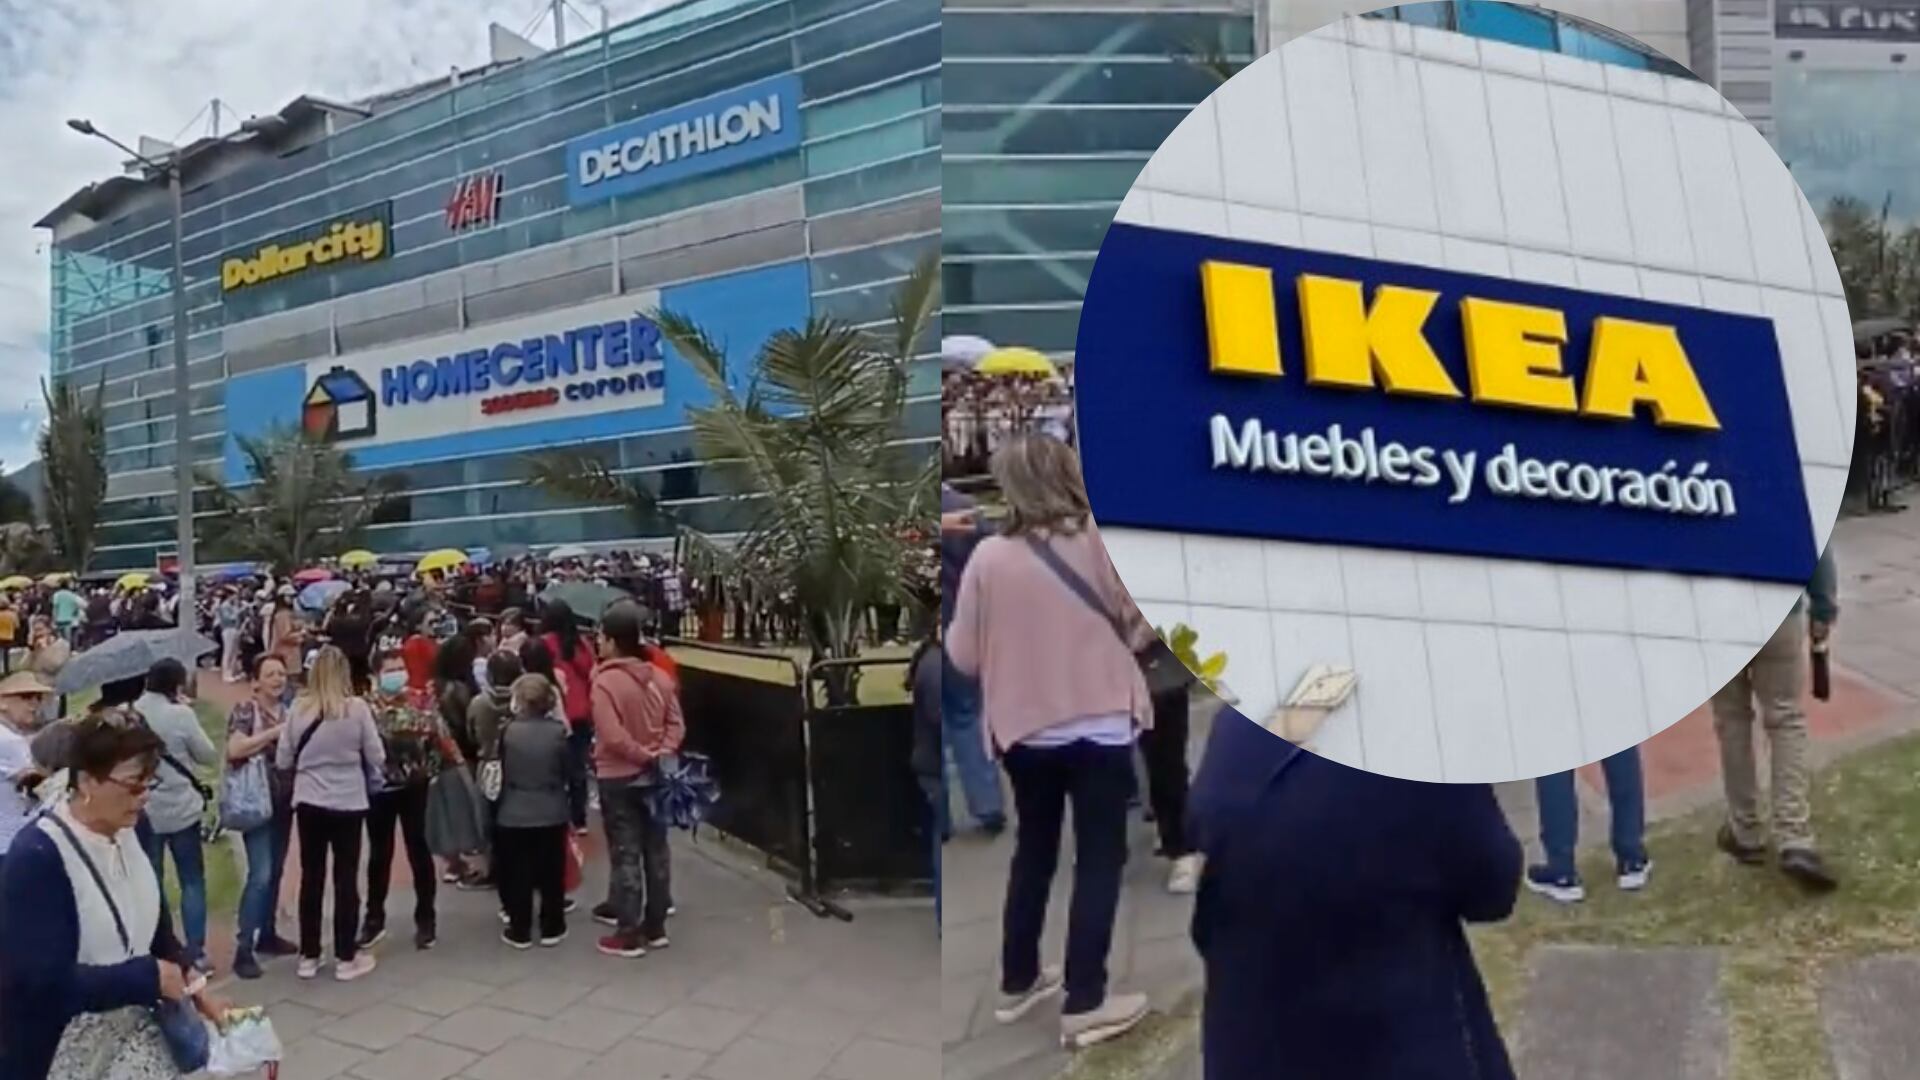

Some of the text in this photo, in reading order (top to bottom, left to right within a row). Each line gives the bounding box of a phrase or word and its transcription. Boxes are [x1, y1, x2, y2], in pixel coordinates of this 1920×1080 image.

[578, 94, 783, 187] DECATHLON
[222, 219, 385, 291] Dollarcity
[381, 316, 664, 406] HOMECENTER
[564, 371, 665, 401] corona
[1201, 259, 1722, 430] IKEA
[1210, 414, 1738, 517] Muebles y decoración
